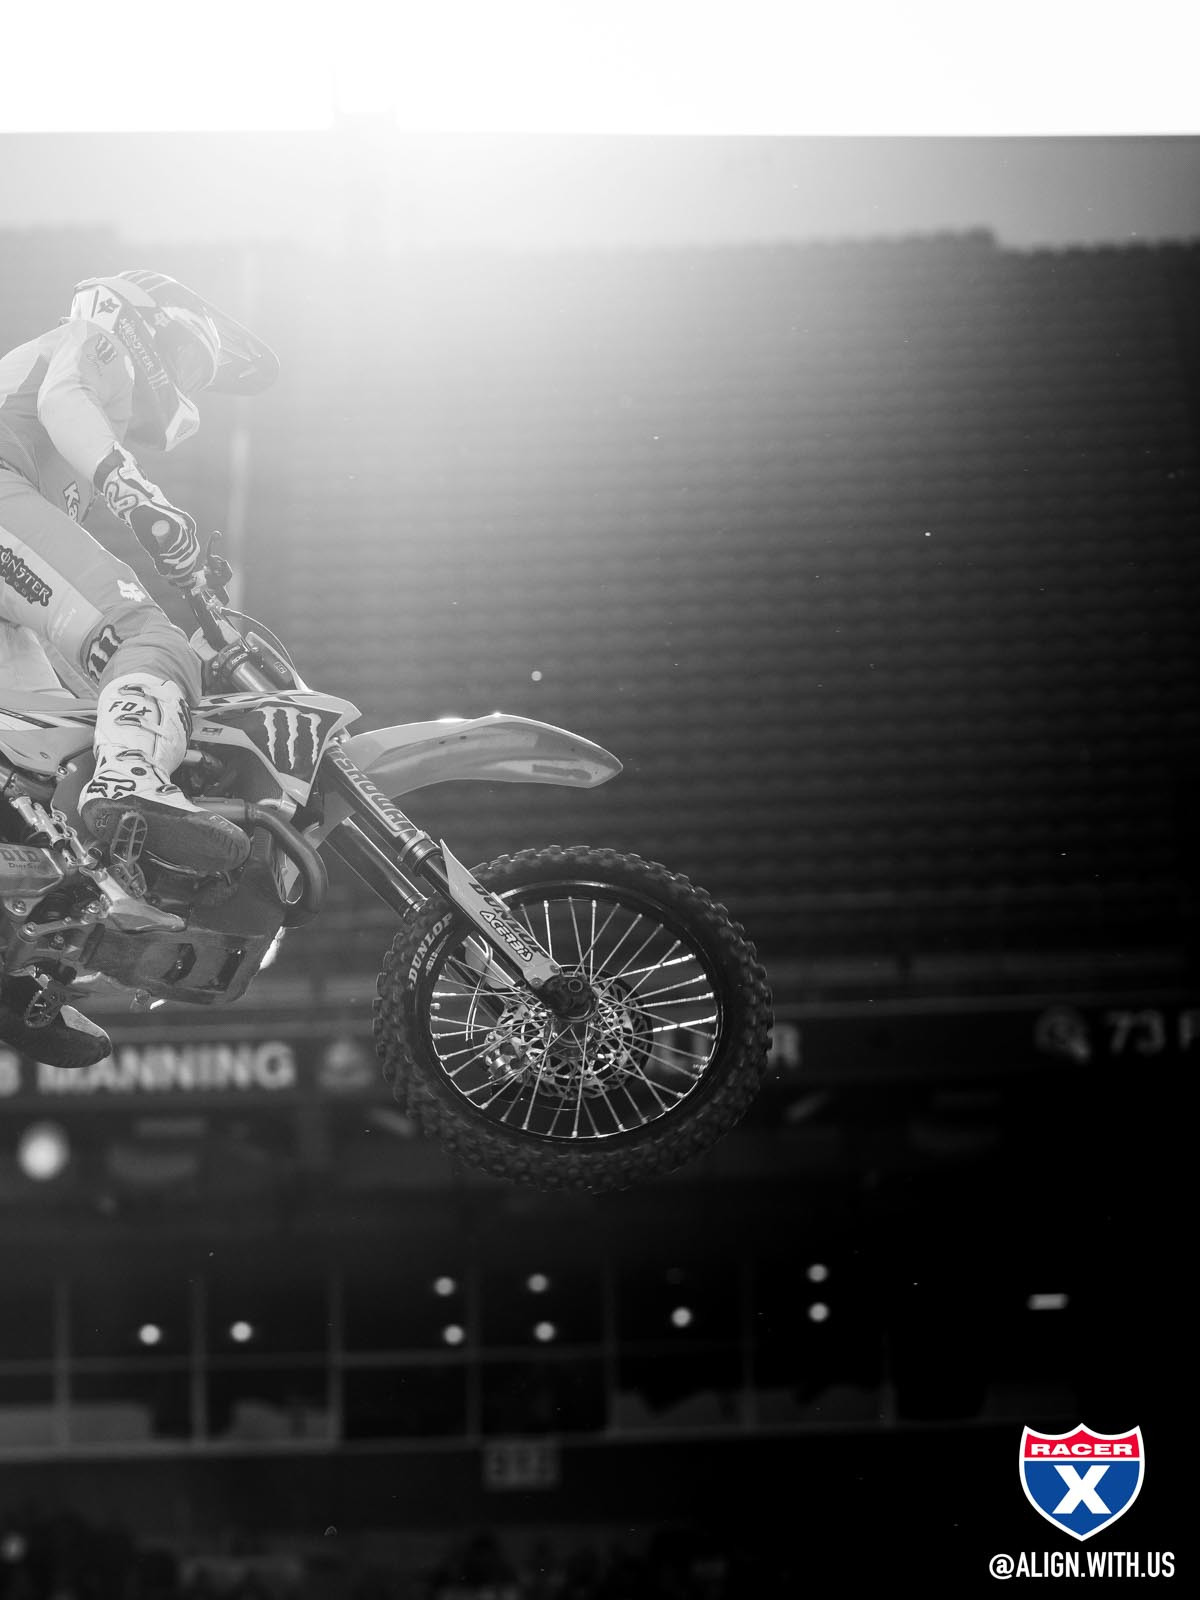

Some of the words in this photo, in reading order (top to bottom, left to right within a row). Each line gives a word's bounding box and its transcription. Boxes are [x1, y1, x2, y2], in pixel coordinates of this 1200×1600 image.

[108, 701, 152, 716] FOX
[408, 912, 453, 985] DUNLOP
[1109, 1009, 1168, 1056] 73
